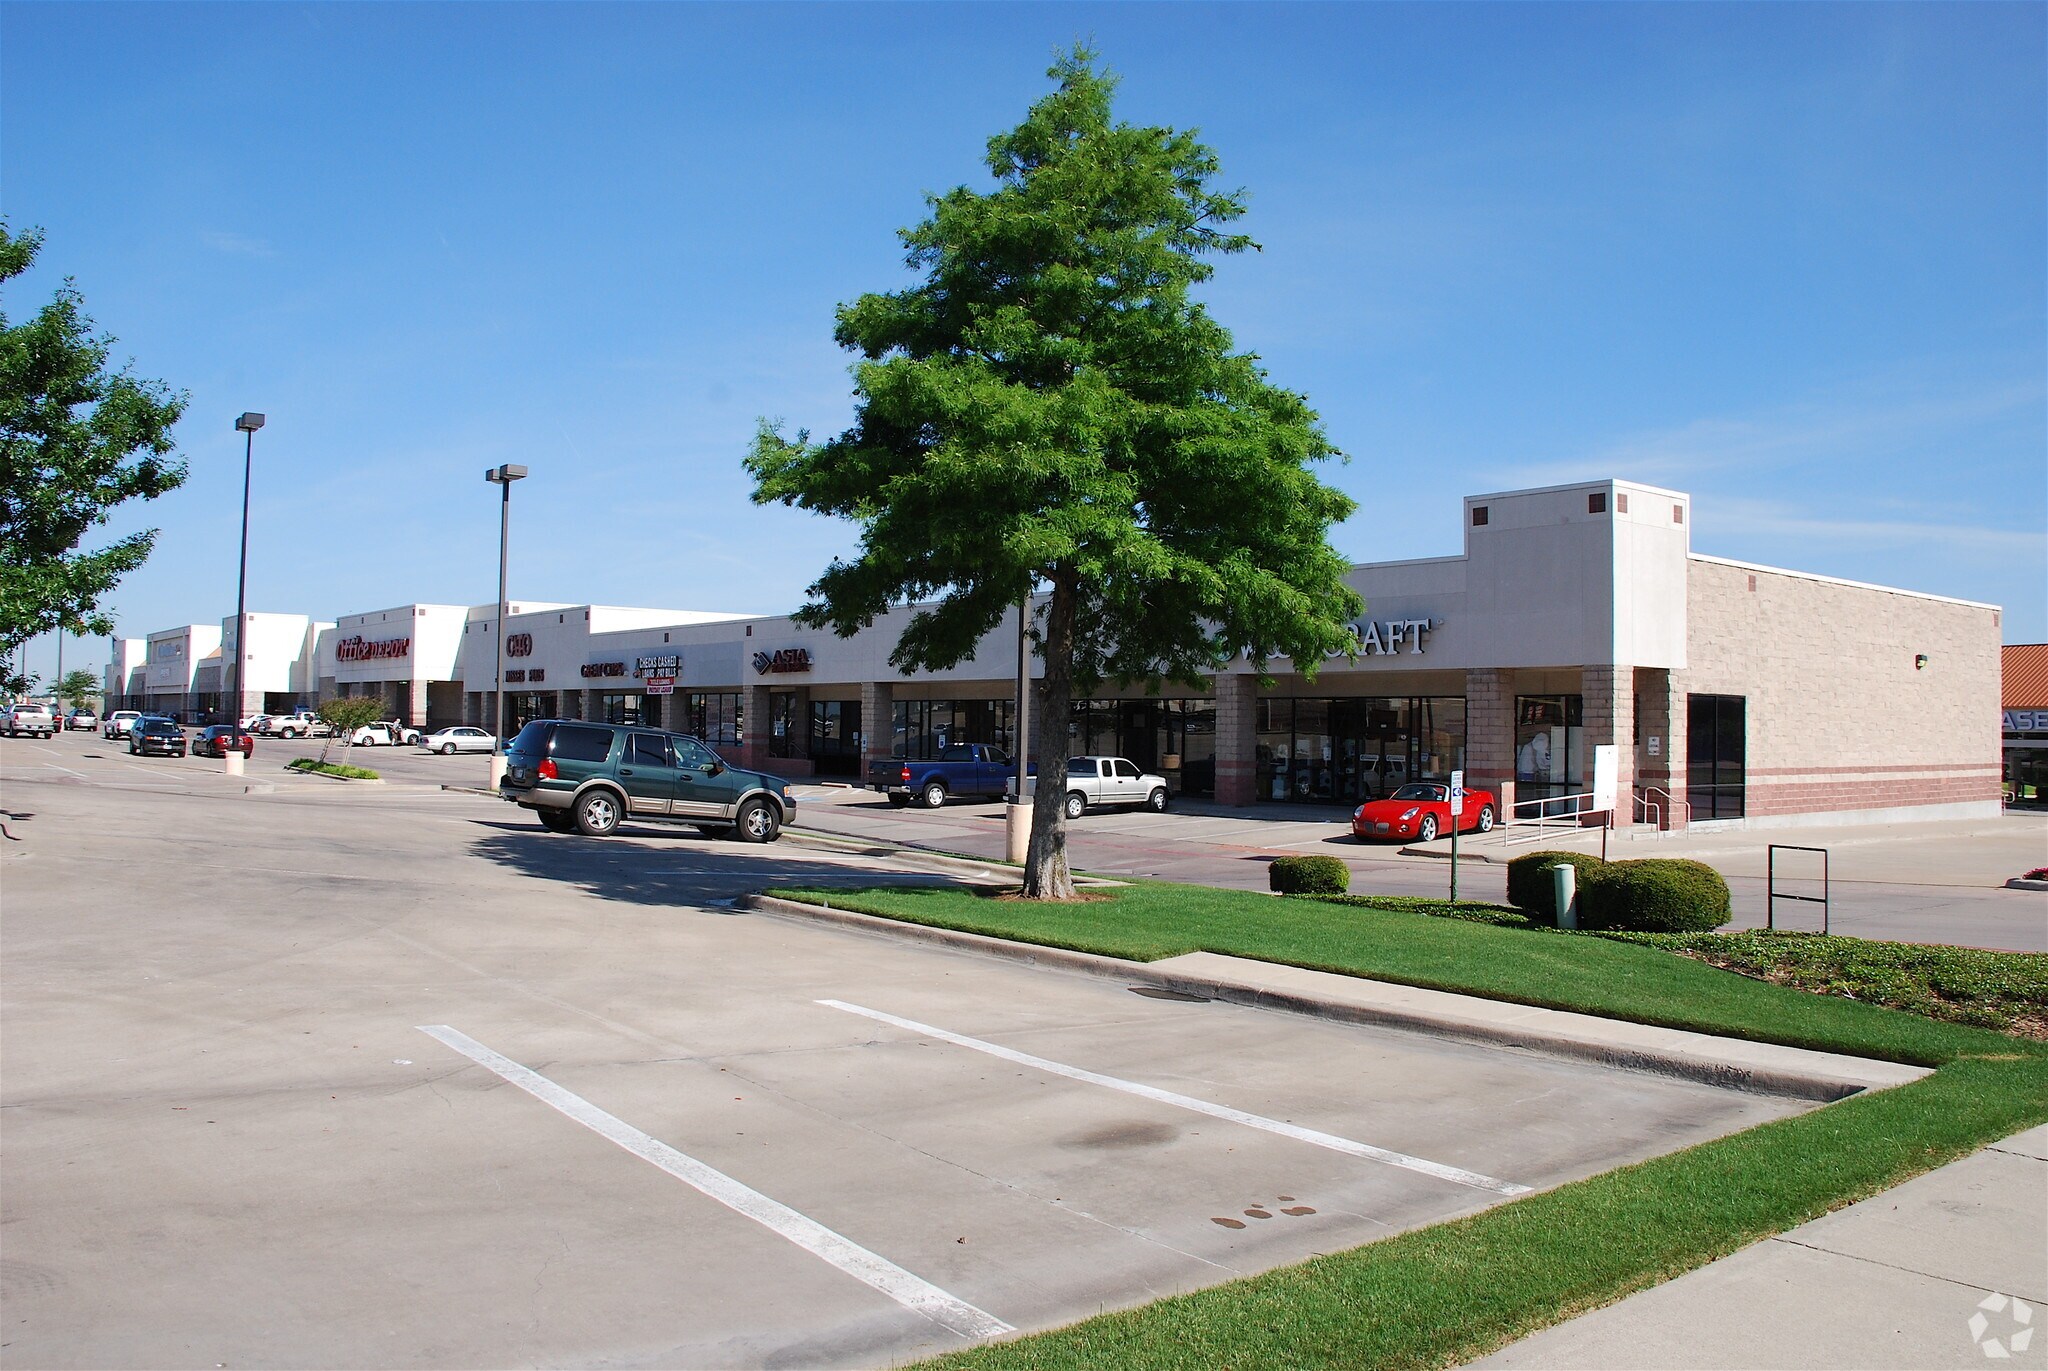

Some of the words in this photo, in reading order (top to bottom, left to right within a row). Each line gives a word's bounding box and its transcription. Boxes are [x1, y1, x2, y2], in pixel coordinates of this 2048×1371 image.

[336, 635, 370, 662] Office
[370, 638, 409, 659] DEPOT
[639, 656, 657, 669] CHECKS
[657, 655, 677, 667] CASHED
